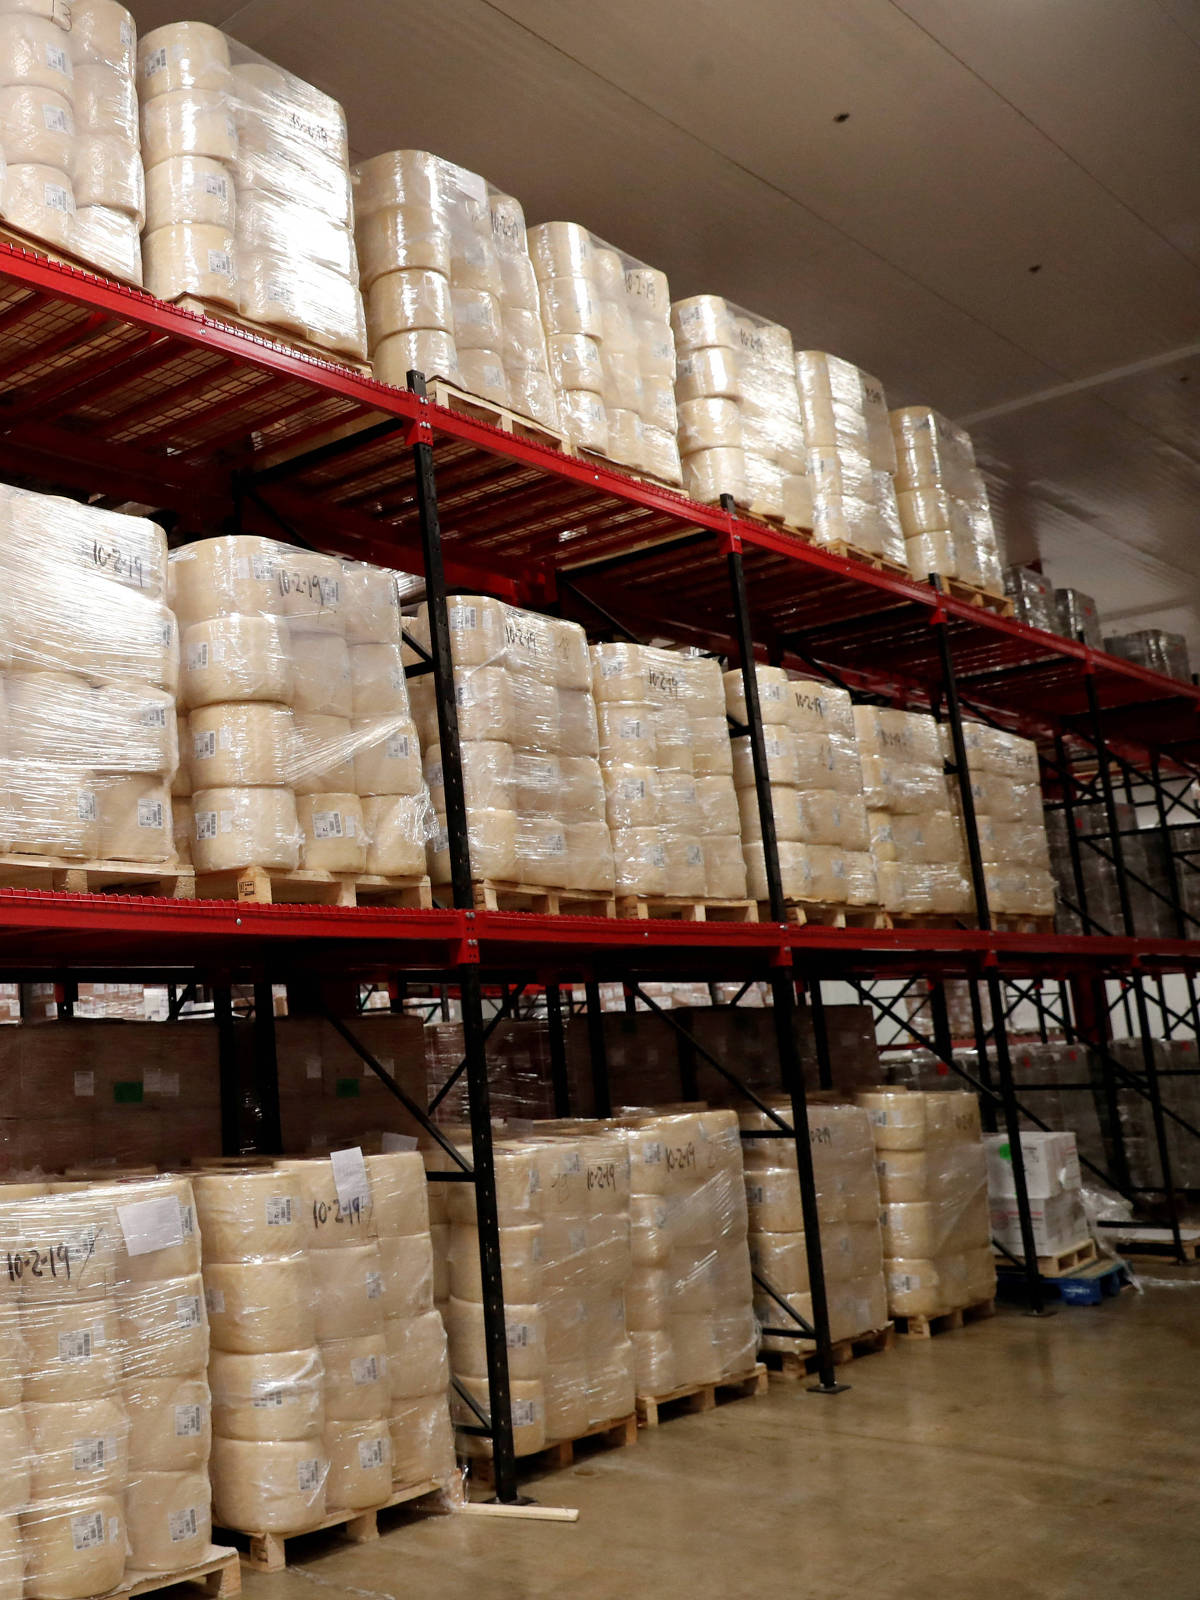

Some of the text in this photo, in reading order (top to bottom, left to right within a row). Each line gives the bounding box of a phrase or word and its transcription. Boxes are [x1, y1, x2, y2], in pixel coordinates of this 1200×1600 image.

[277, 571, 324, 606] 10-2-19
[586, 1163, 618, 1192] 10-2-19
[311, 1196, 361, 1230] 10-2-19
[6, 1243, 72, 1282] 10-2-19
